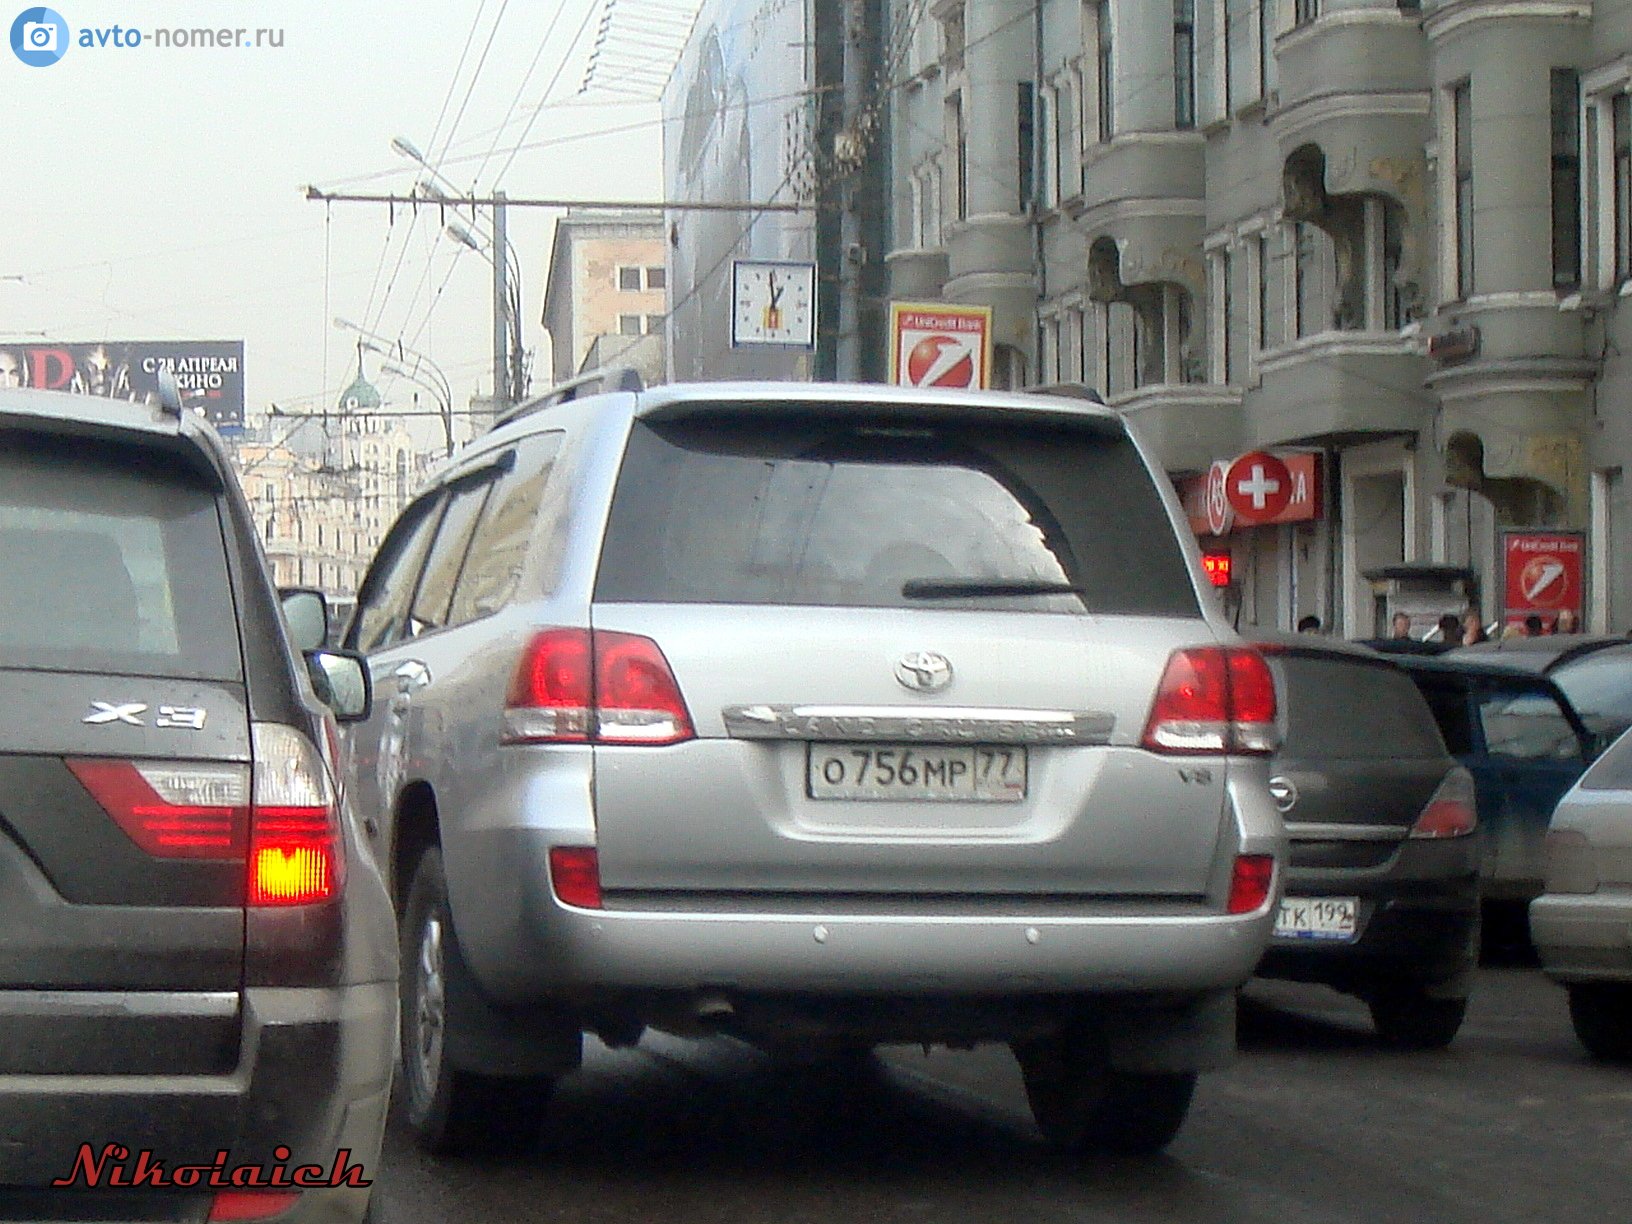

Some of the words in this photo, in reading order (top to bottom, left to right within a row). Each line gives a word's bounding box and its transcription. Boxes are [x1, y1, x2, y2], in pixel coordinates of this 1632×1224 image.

[178, 357, 238, 373] АПРЕЛЯ
[175, 373, 223, 389] КИНО
[81, 700, 208, 730] X3
